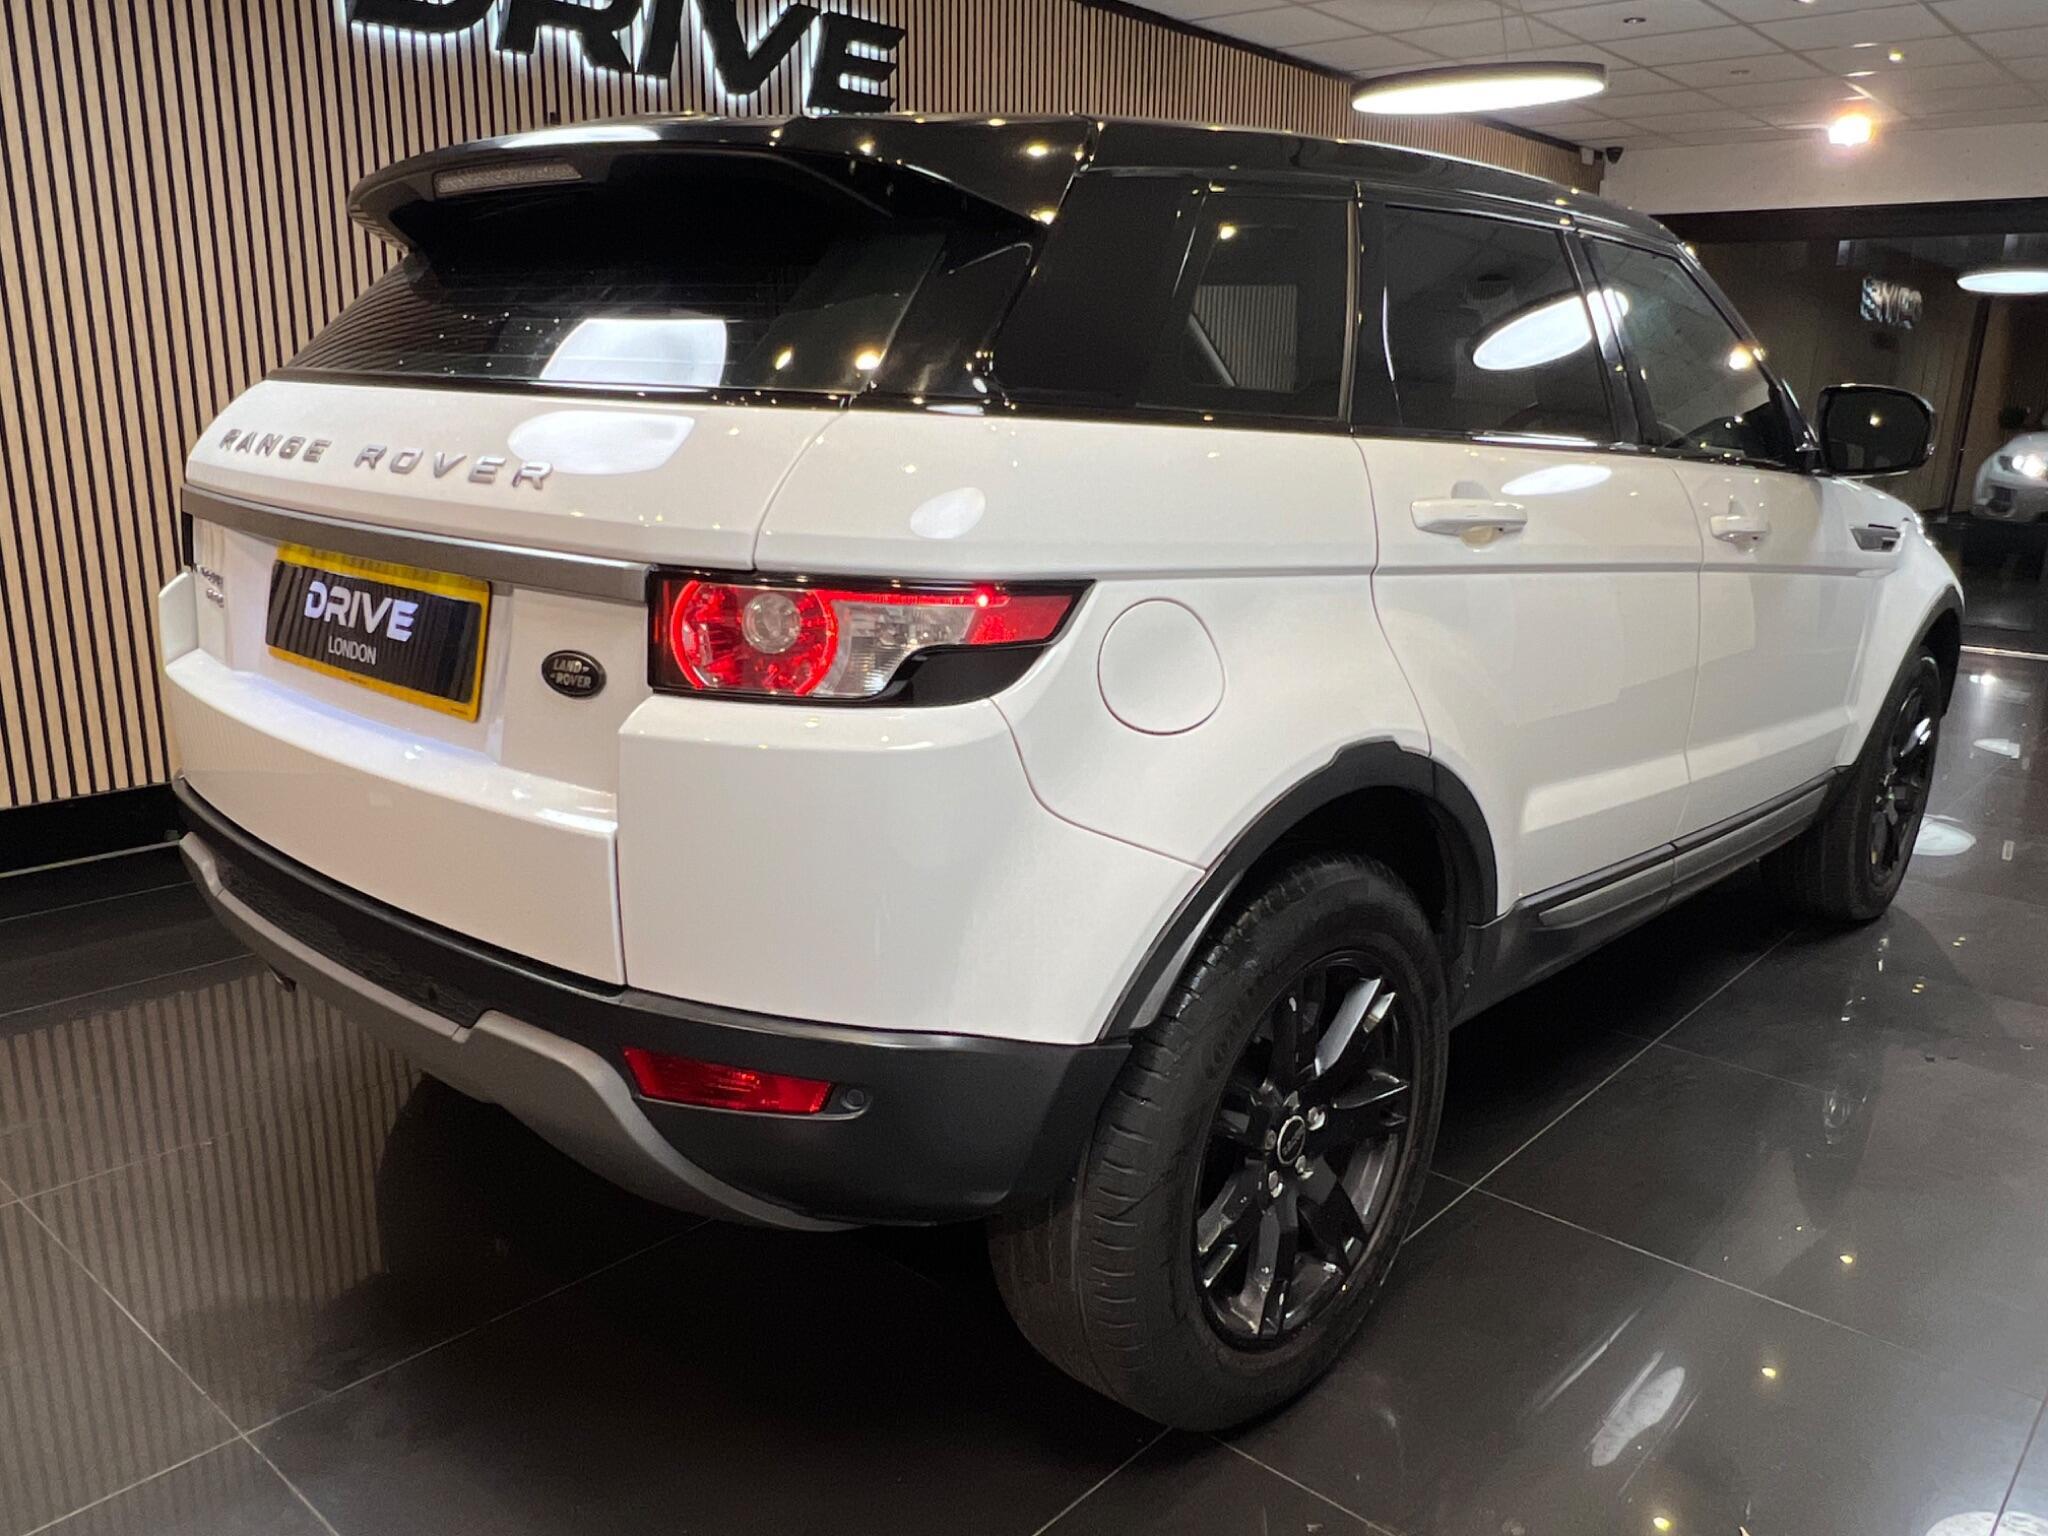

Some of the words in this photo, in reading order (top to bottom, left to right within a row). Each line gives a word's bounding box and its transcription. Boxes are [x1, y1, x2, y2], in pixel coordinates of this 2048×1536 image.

[219, 428, 332, 463] RANGE
[354, 443, 554, 491] ROVER
[303, 580, 419, 642] DRIVE
[327, 635, 377, 665] LONDON
[553, 658, 583, 673] LAND
[555, 671, 592, 689] ROVER
